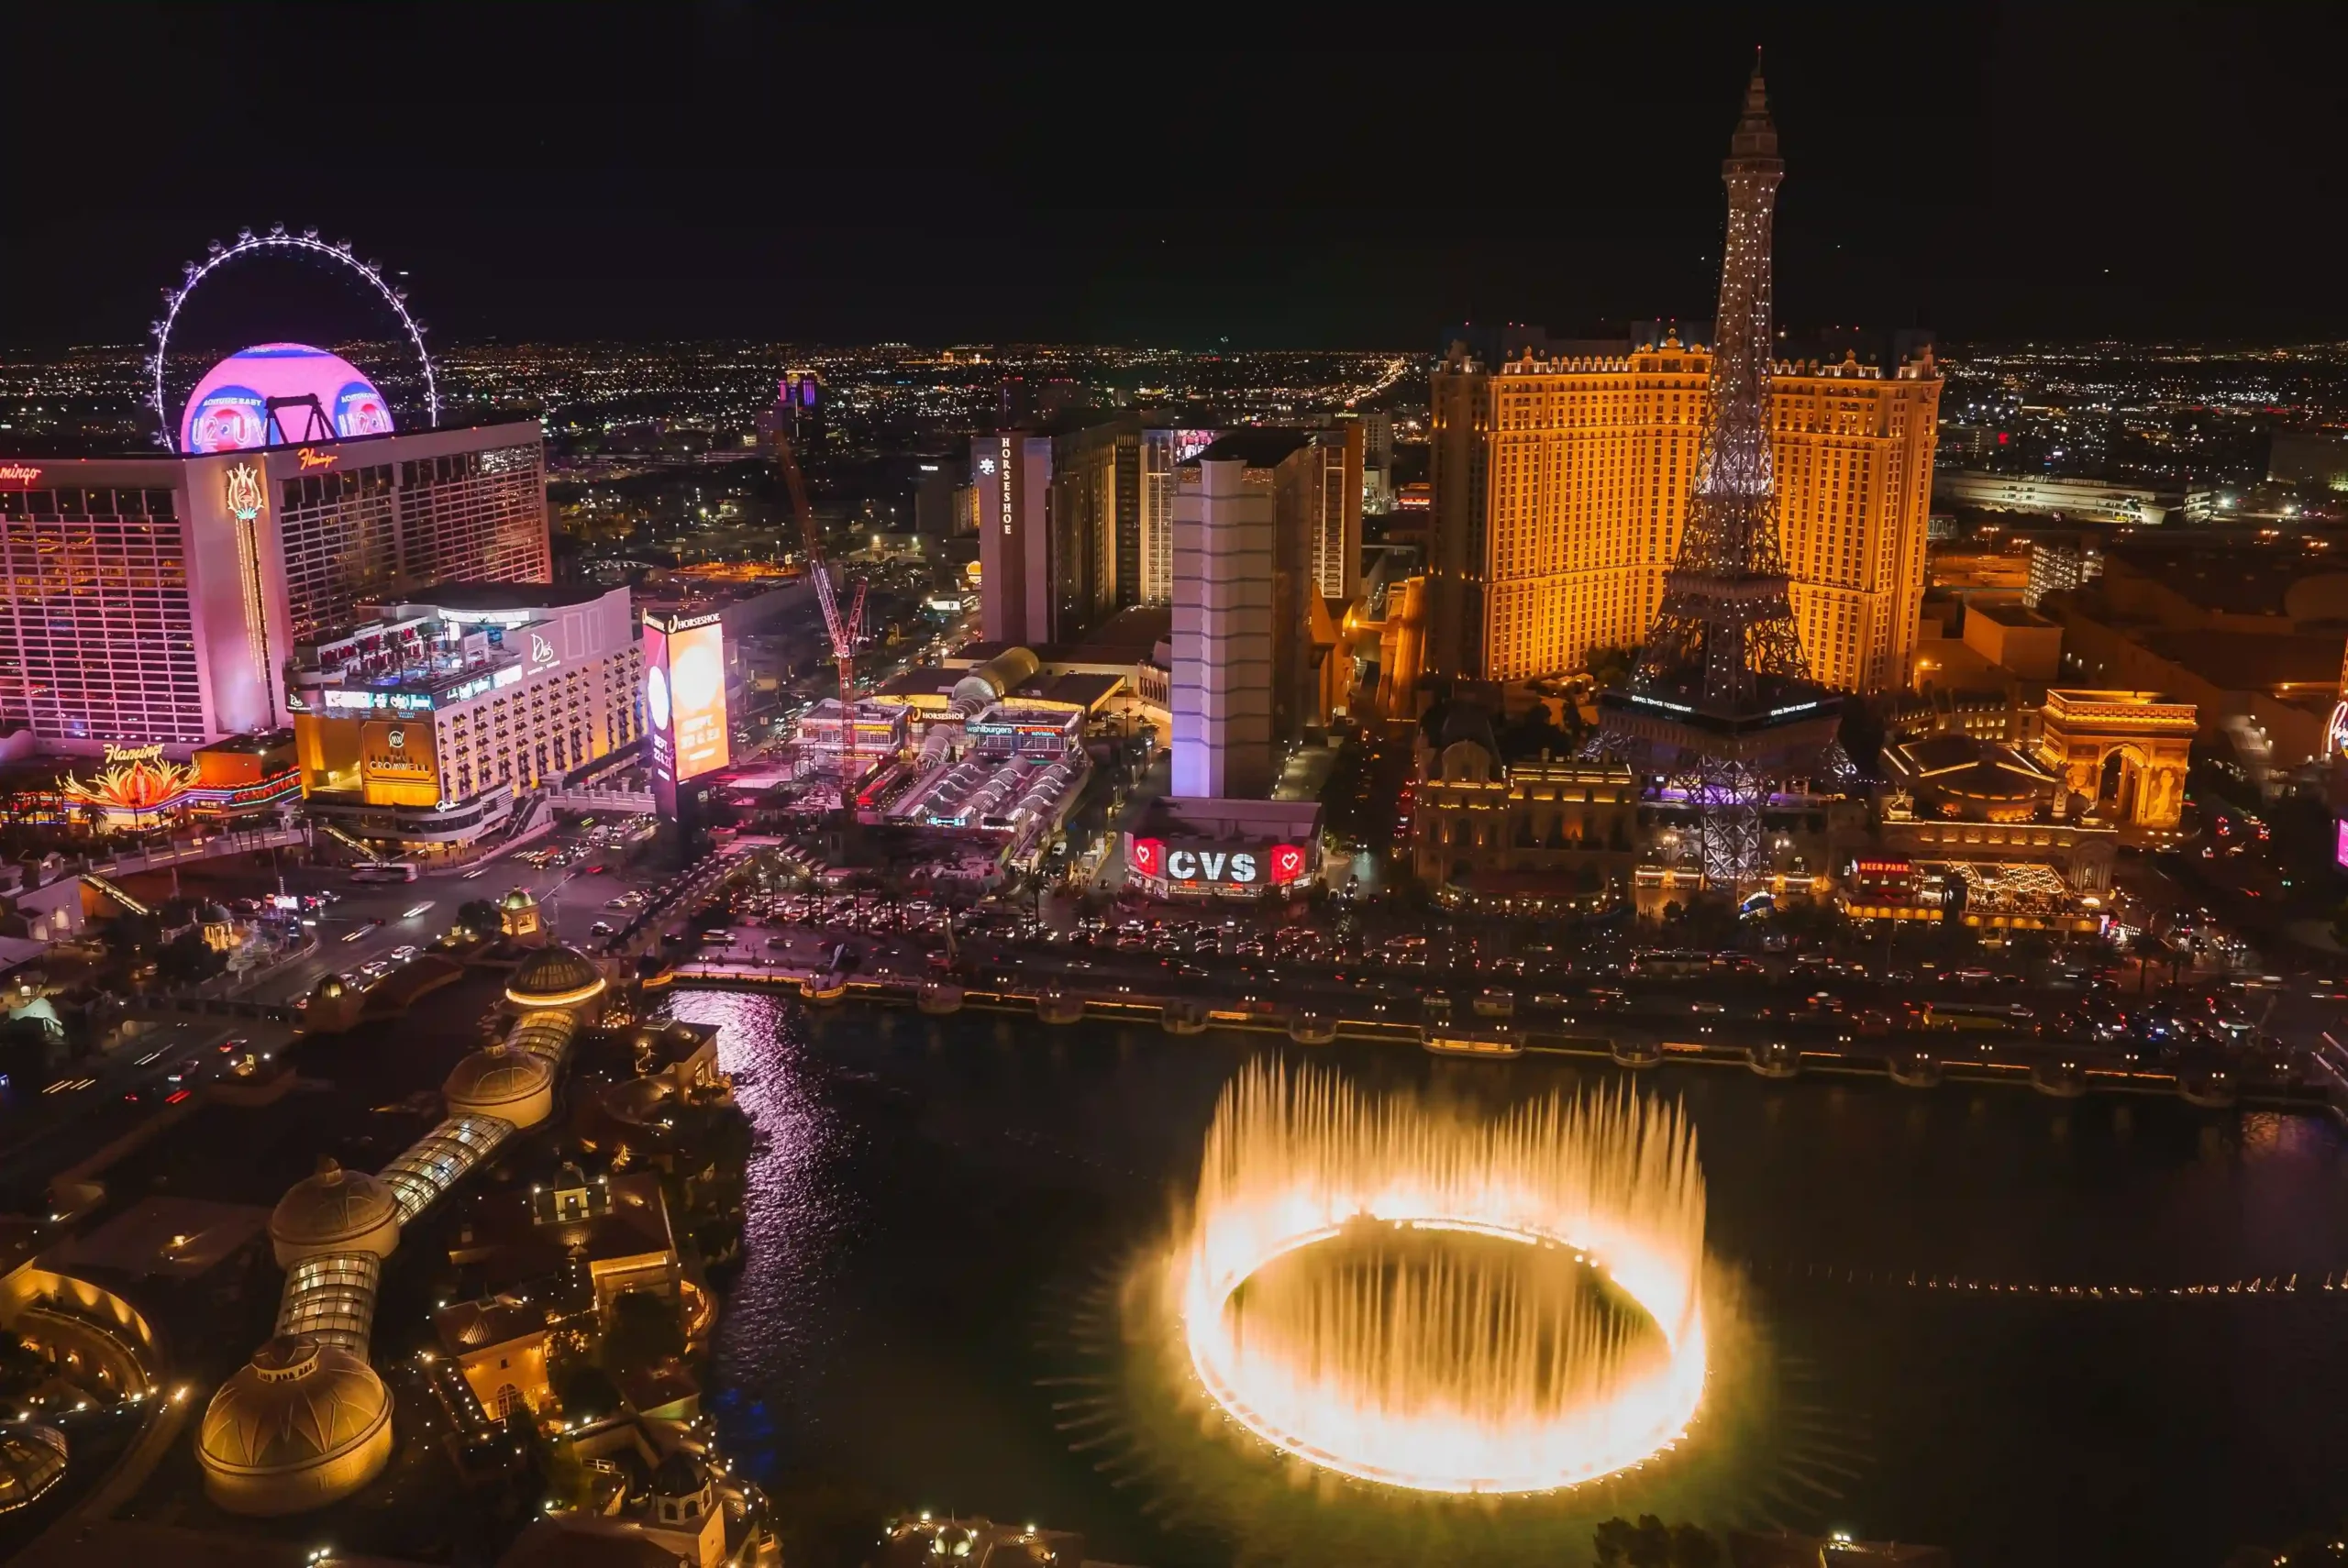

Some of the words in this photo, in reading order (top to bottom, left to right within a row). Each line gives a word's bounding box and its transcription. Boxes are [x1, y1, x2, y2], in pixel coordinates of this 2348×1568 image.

[1002, 437, 1012, 535] HORSESHOE
[677, 613, 721, 630] HORSESHOE
[922, 712, 965, 721] HORSESHOE
[966, 724, 1013, 735] wahlburgers
[103, 743, 165, 763] Flamingo
[370, 760, 429, 773] CROMWELL
[1168, 851, 1257, 882] CVS
[1859, 863, 1884, 871] BEER
[1885, 864, 1909, 872] PARK
